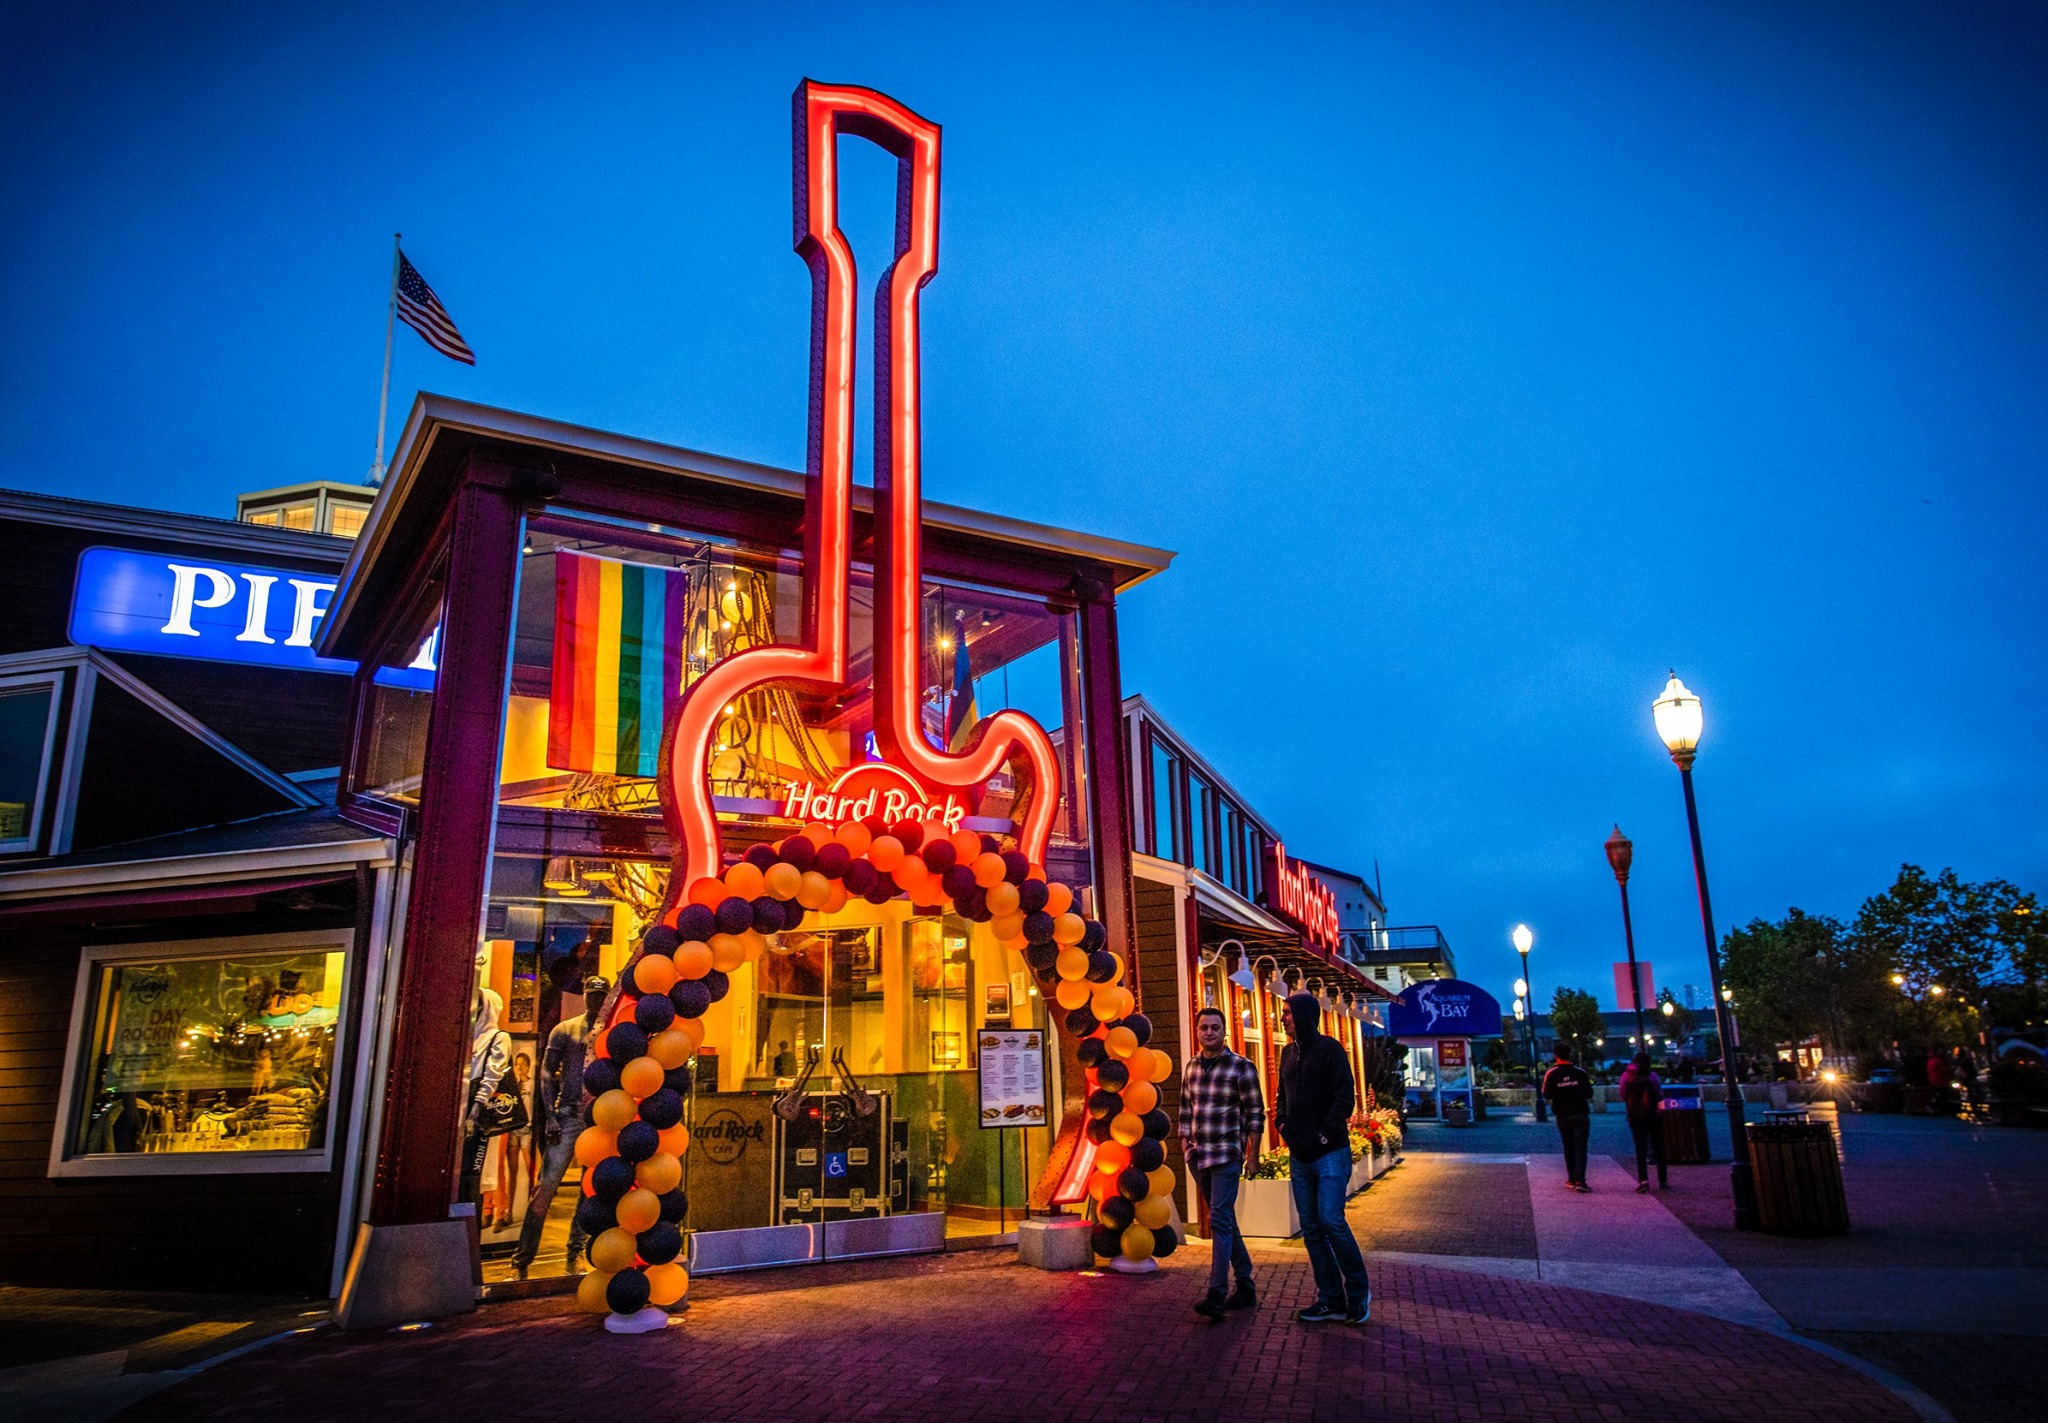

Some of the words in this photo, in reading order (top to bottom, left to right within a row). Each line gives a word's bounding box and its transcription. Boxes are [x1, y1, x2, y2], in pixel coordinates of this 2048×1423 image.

[785, 780, 879, 823] Hard
[884, 788, 965, 834] Rock
[1275, 840, 1304, 923] Hard
[1302, 865, 1327, 949] Rock
[150, 1007, 187, 1025] DAY
[1441, 1004, 1470, 1017] BAY
[690, 1119, 724, 1140] ard
[725, 1119, 764, 1142] Rock
[472, 1145, 486, 1172] ROCK
